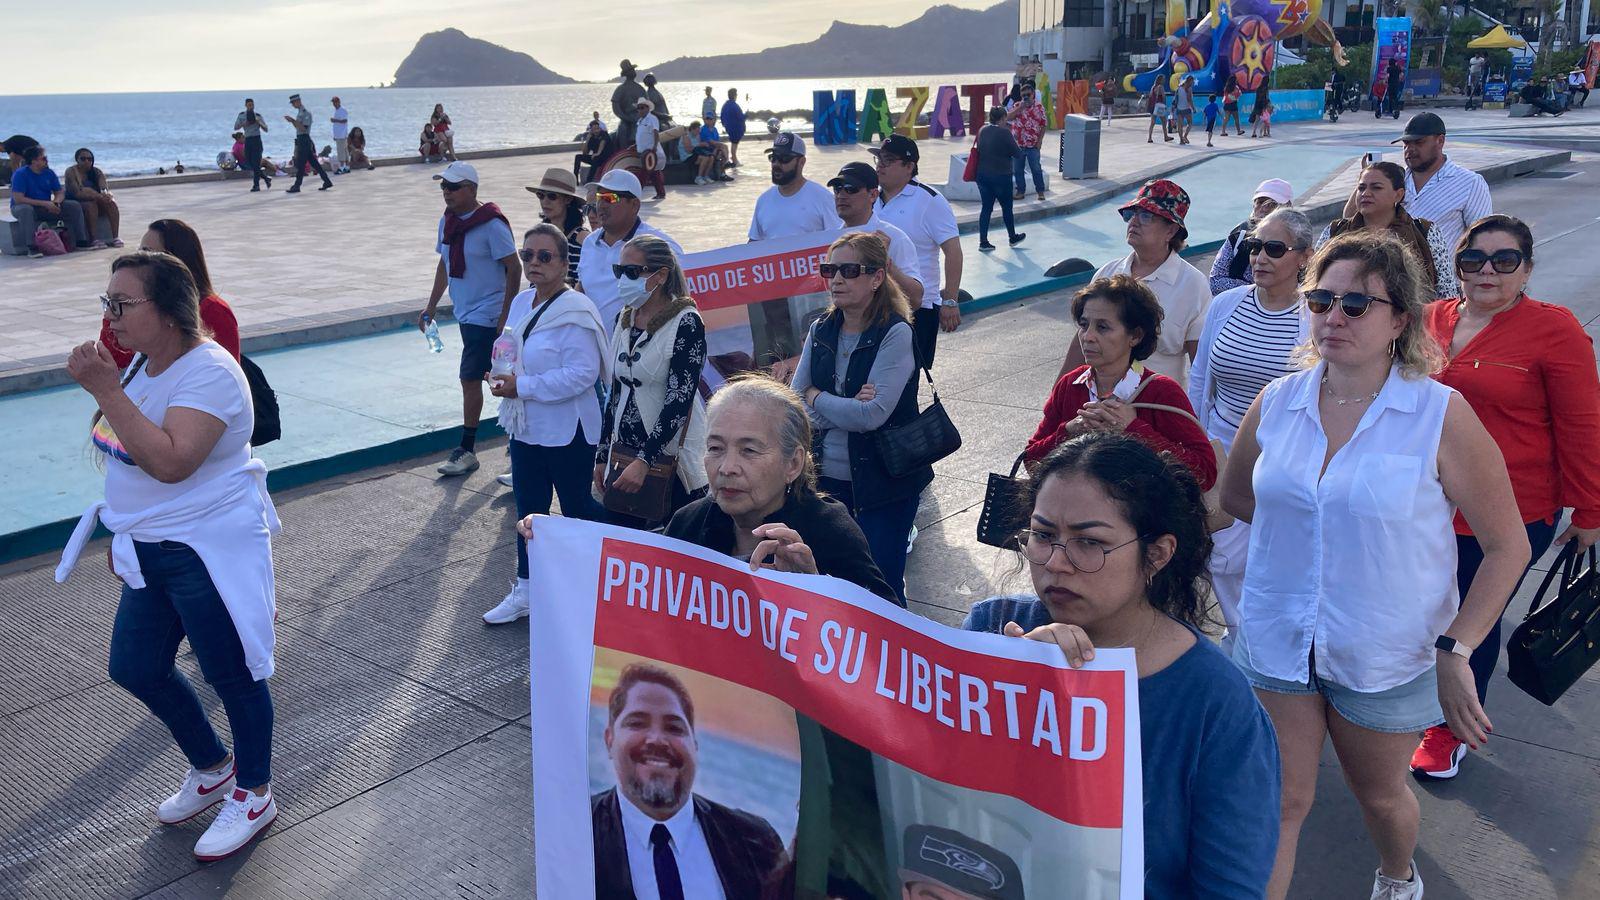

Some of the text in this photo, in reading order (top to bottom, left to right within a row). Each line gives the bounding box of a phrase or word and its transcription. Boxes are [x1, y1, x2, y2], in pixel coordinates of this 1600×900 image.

[724, 267, 748, 289] DE
[751, 262, 775, 284] SU
[603, 556, 1108, 762] PRIVADO DE SU LIBERTAD
